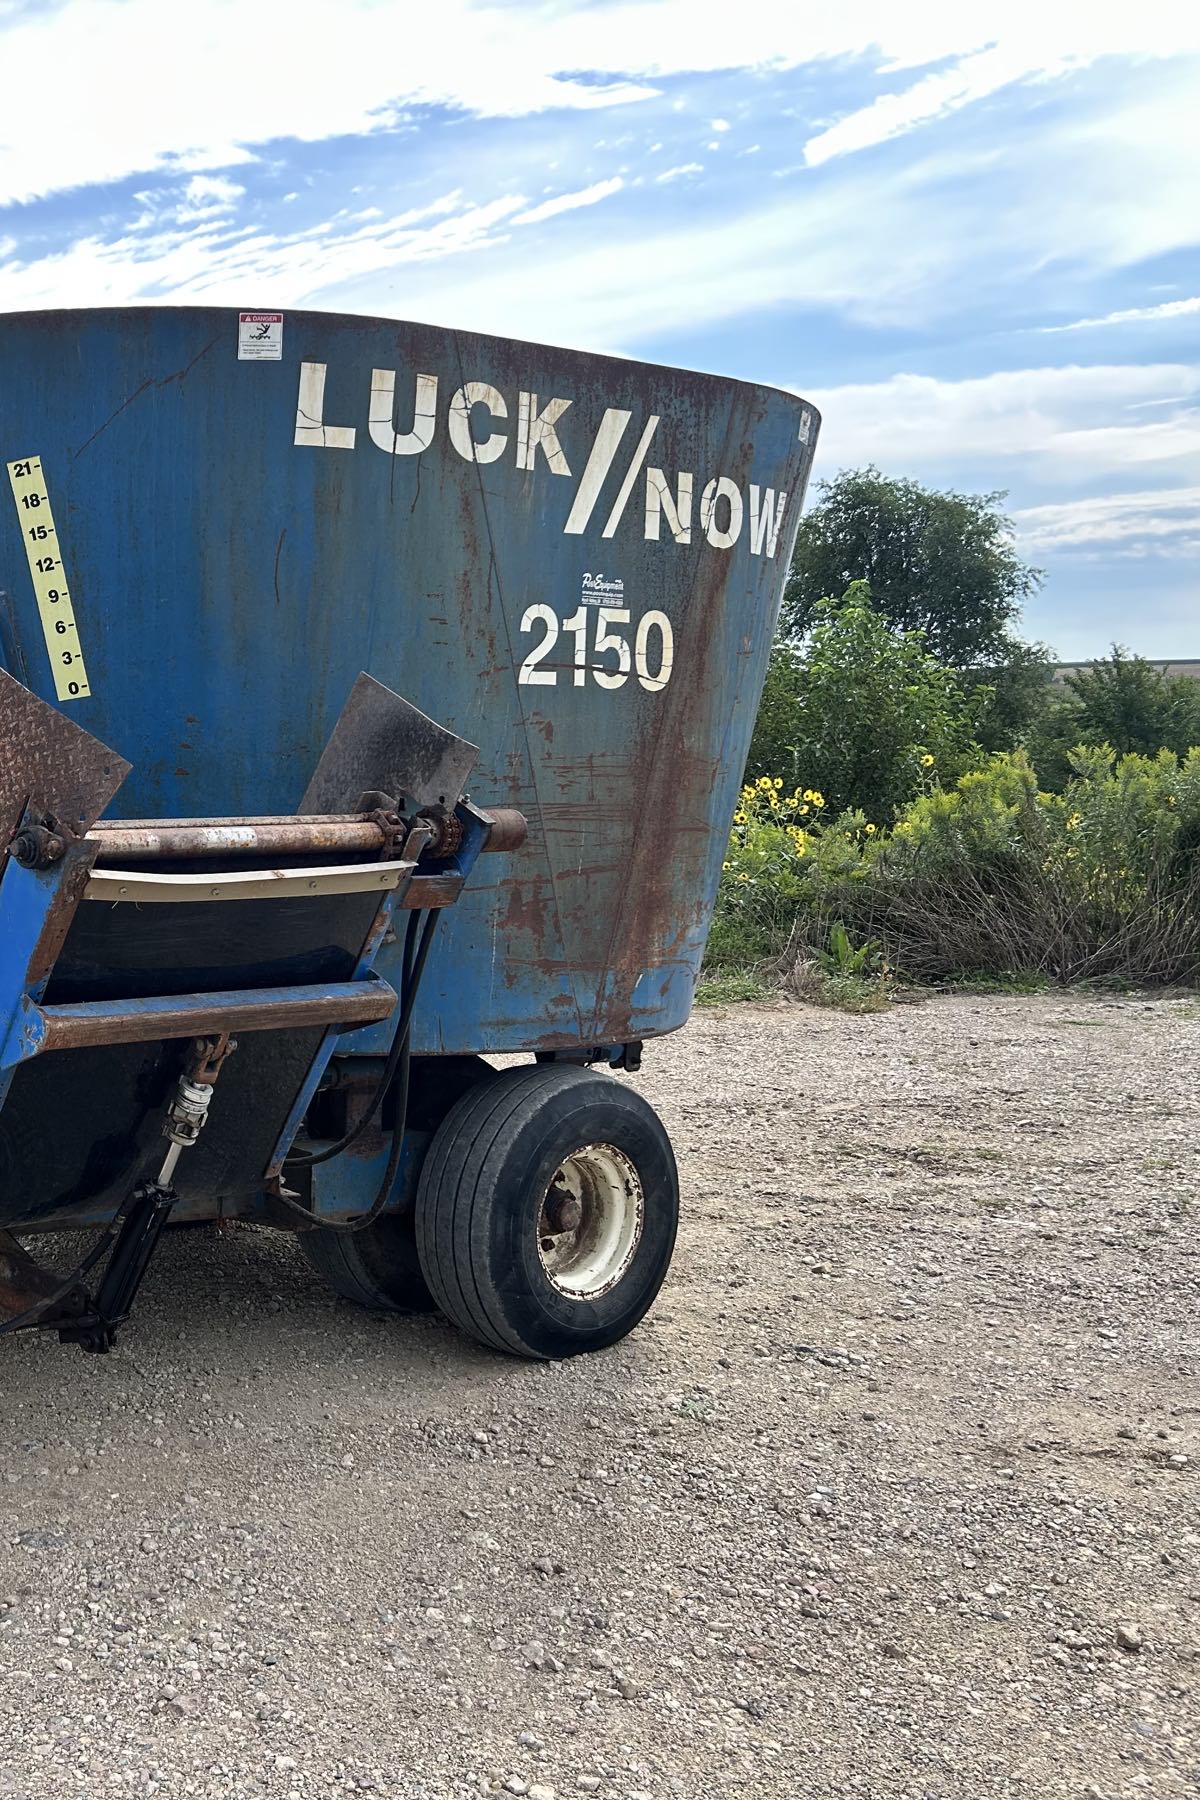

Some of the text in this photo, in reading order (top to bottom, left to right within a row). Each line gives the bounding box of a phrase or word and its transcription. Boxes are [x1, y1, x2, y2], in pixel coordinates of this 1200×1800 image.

[294, 361, 573, 477] LUCK
[644, 467, 787, 559] NOW
[518, 603, 674, 692] 2150
